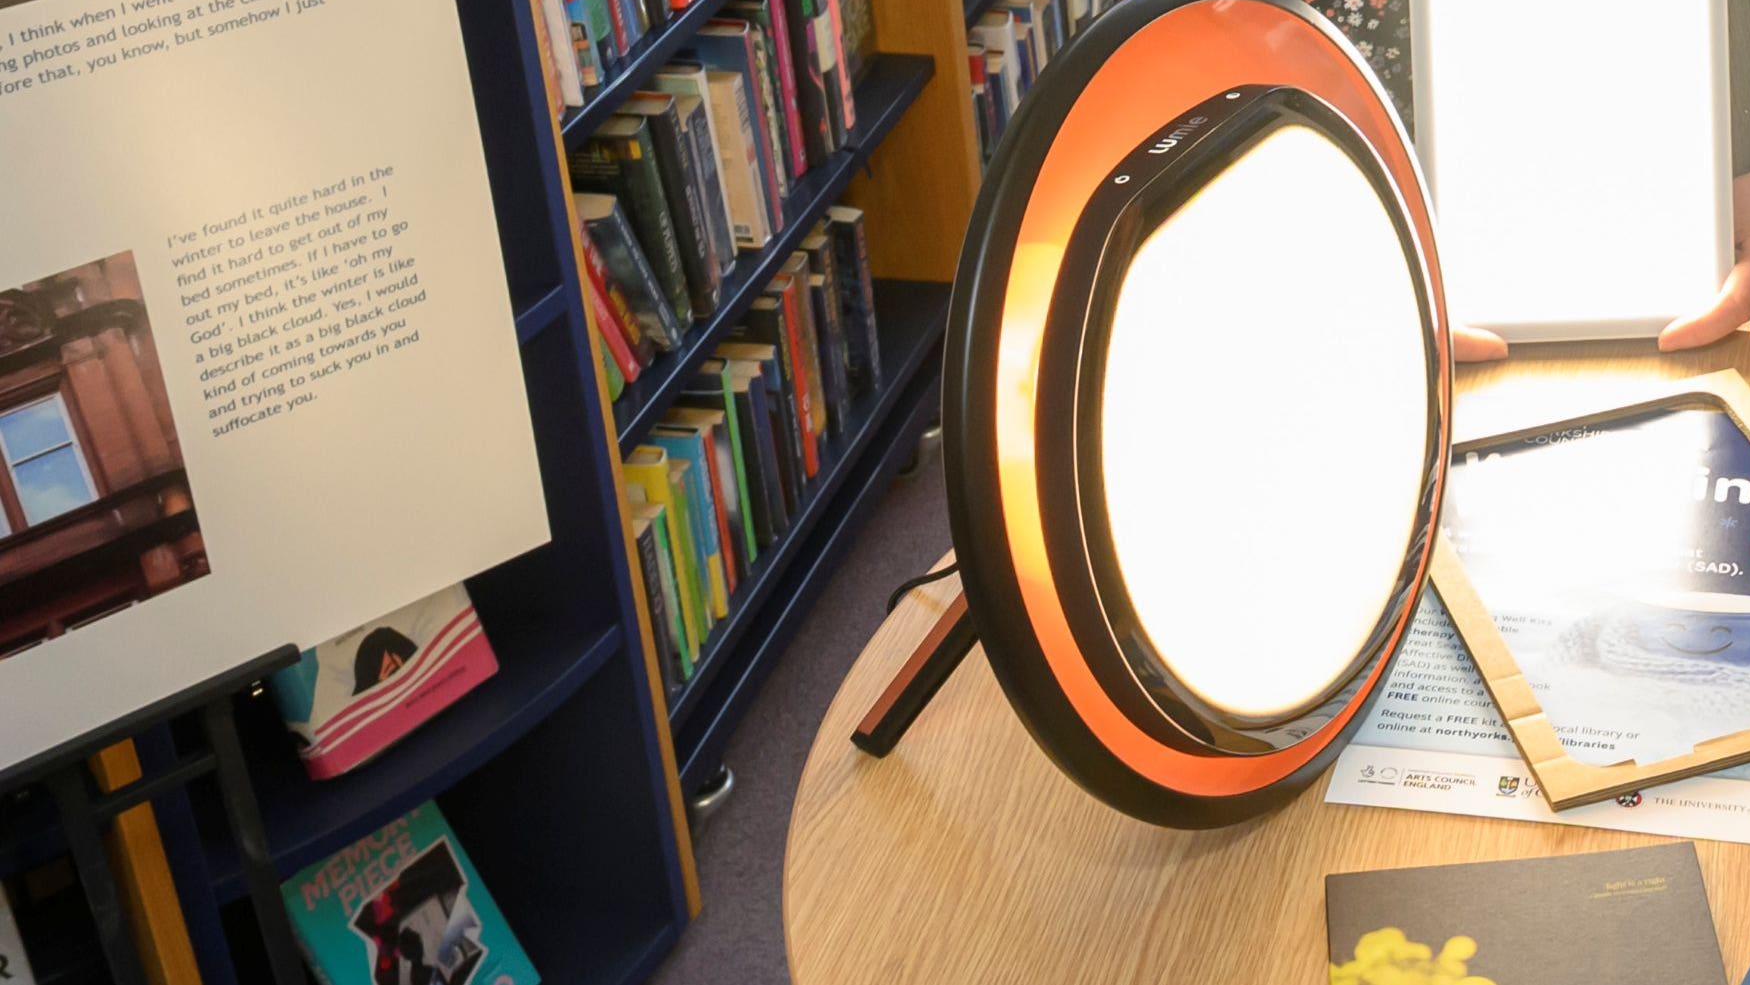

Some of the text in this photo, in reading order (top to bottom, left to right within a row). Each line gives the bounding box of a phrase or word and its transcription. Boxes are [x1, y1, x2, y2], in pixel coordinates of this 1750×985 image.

[8, 32, 14, 46] I
[19, 19, 65, 42] think
[69, 8, 116, 28] when
[120, 1, 126, 15] I
[22, 41, 80, 69] photos
[86, 27, 117, 47] and
[121, 12, 182, 37] looking
[186, 5, 204, 19] at
[37, 64, 80, 83] that,
[86, 53, 117, 73] you
[120, 39, 169, 60] know,
[173, 27, 203, 45] but
[207, 7, 280, 36] somehow
[285, 0, 290, 14] I
[1148, 116, 1208, 154] lumie
[167, 166, 393, 248] I've found it quite hard in the
[208, 329, 419, 419] and trying to suck you in and
[212, 392, 317, 437] suffocate you.
[1387, 691, 1462, 707] FREE online
[1377, 721, 1418, 735] online
[1419, 725, 1433, 735] at
[1380, 708, 1433, 724] Request
[1446, 715, 1481, 725] FREE
[1481, 716, 1499, 728] kit
[1580, 725, 1641, 741] library or
[1402, 780, 1453, 792] ENGLAND
[1405, 772, 1478, 787] ARTS COUNCIL
[1654, 796, 1676, 806] THE
[1678, 798, 1748, 814] UNIVERSITY
